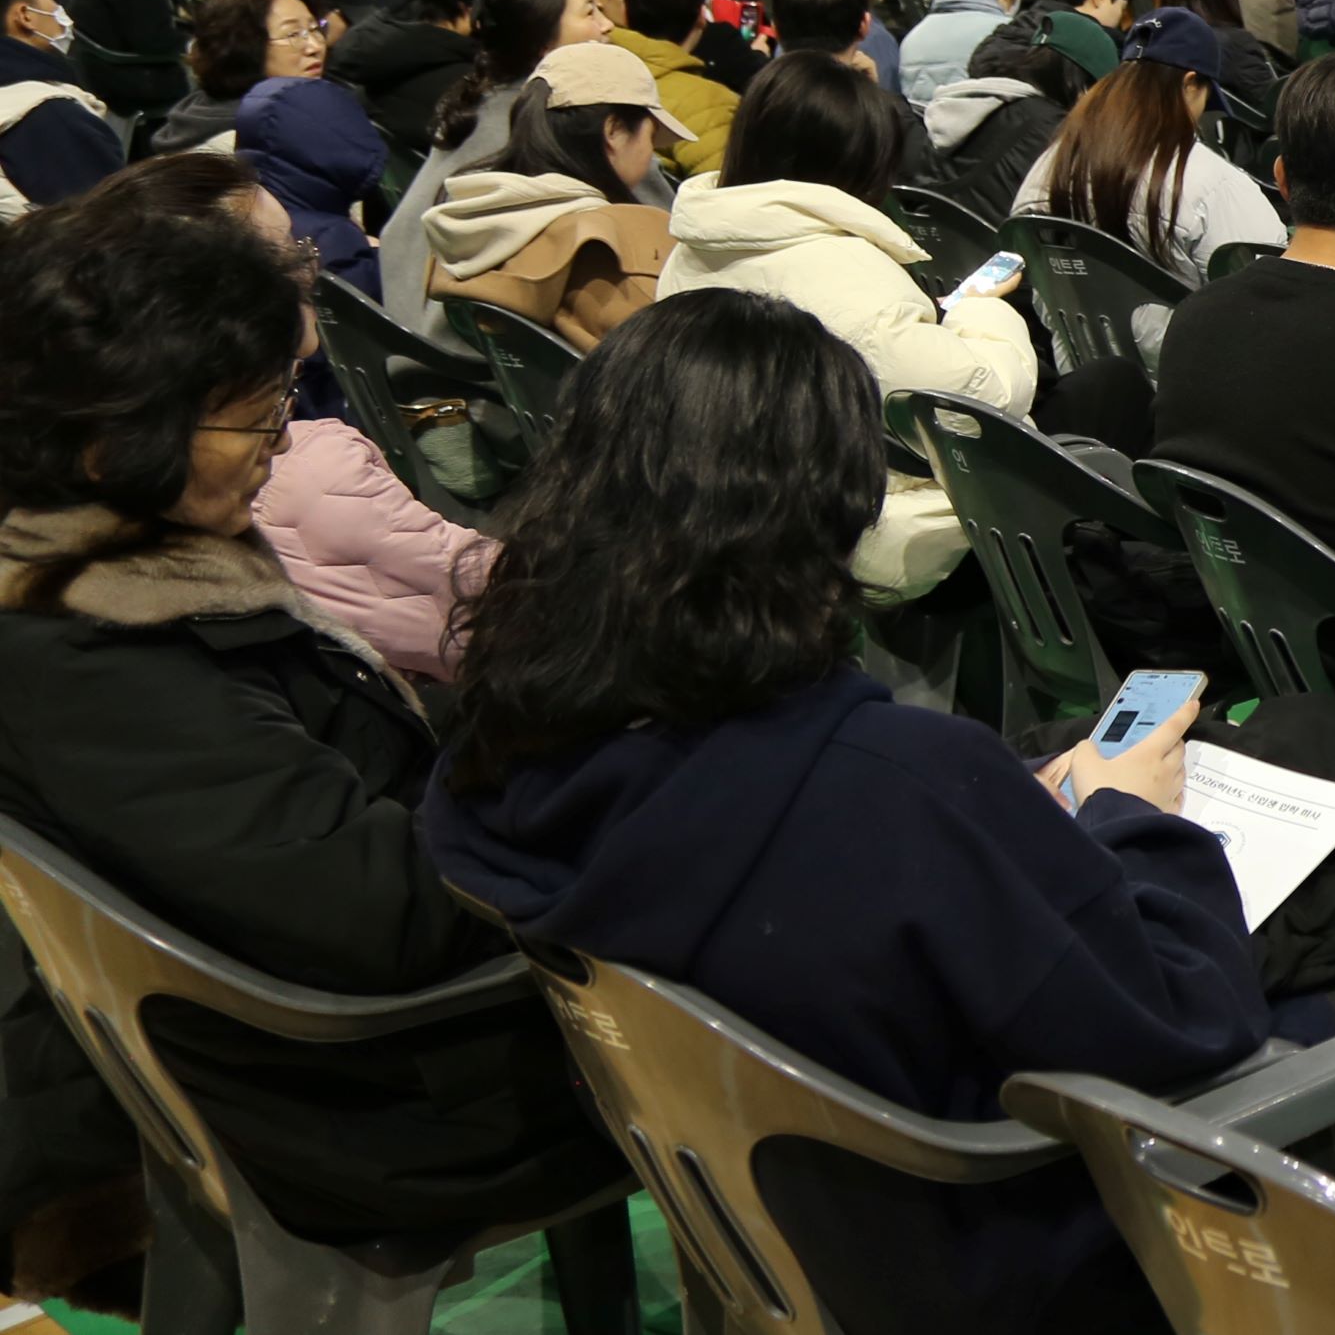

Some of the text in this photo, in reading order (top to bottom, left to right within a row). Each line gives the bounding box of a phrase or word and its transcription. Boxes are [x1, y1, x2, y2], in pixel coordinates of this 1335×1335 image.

[951, 448, 971, 474] 인
[1195, 529, 1246, 564] 인트로
[1189, 771, 1247, 800] 2026학년도
[1163, 1204, 1290, 1289] 인트로
